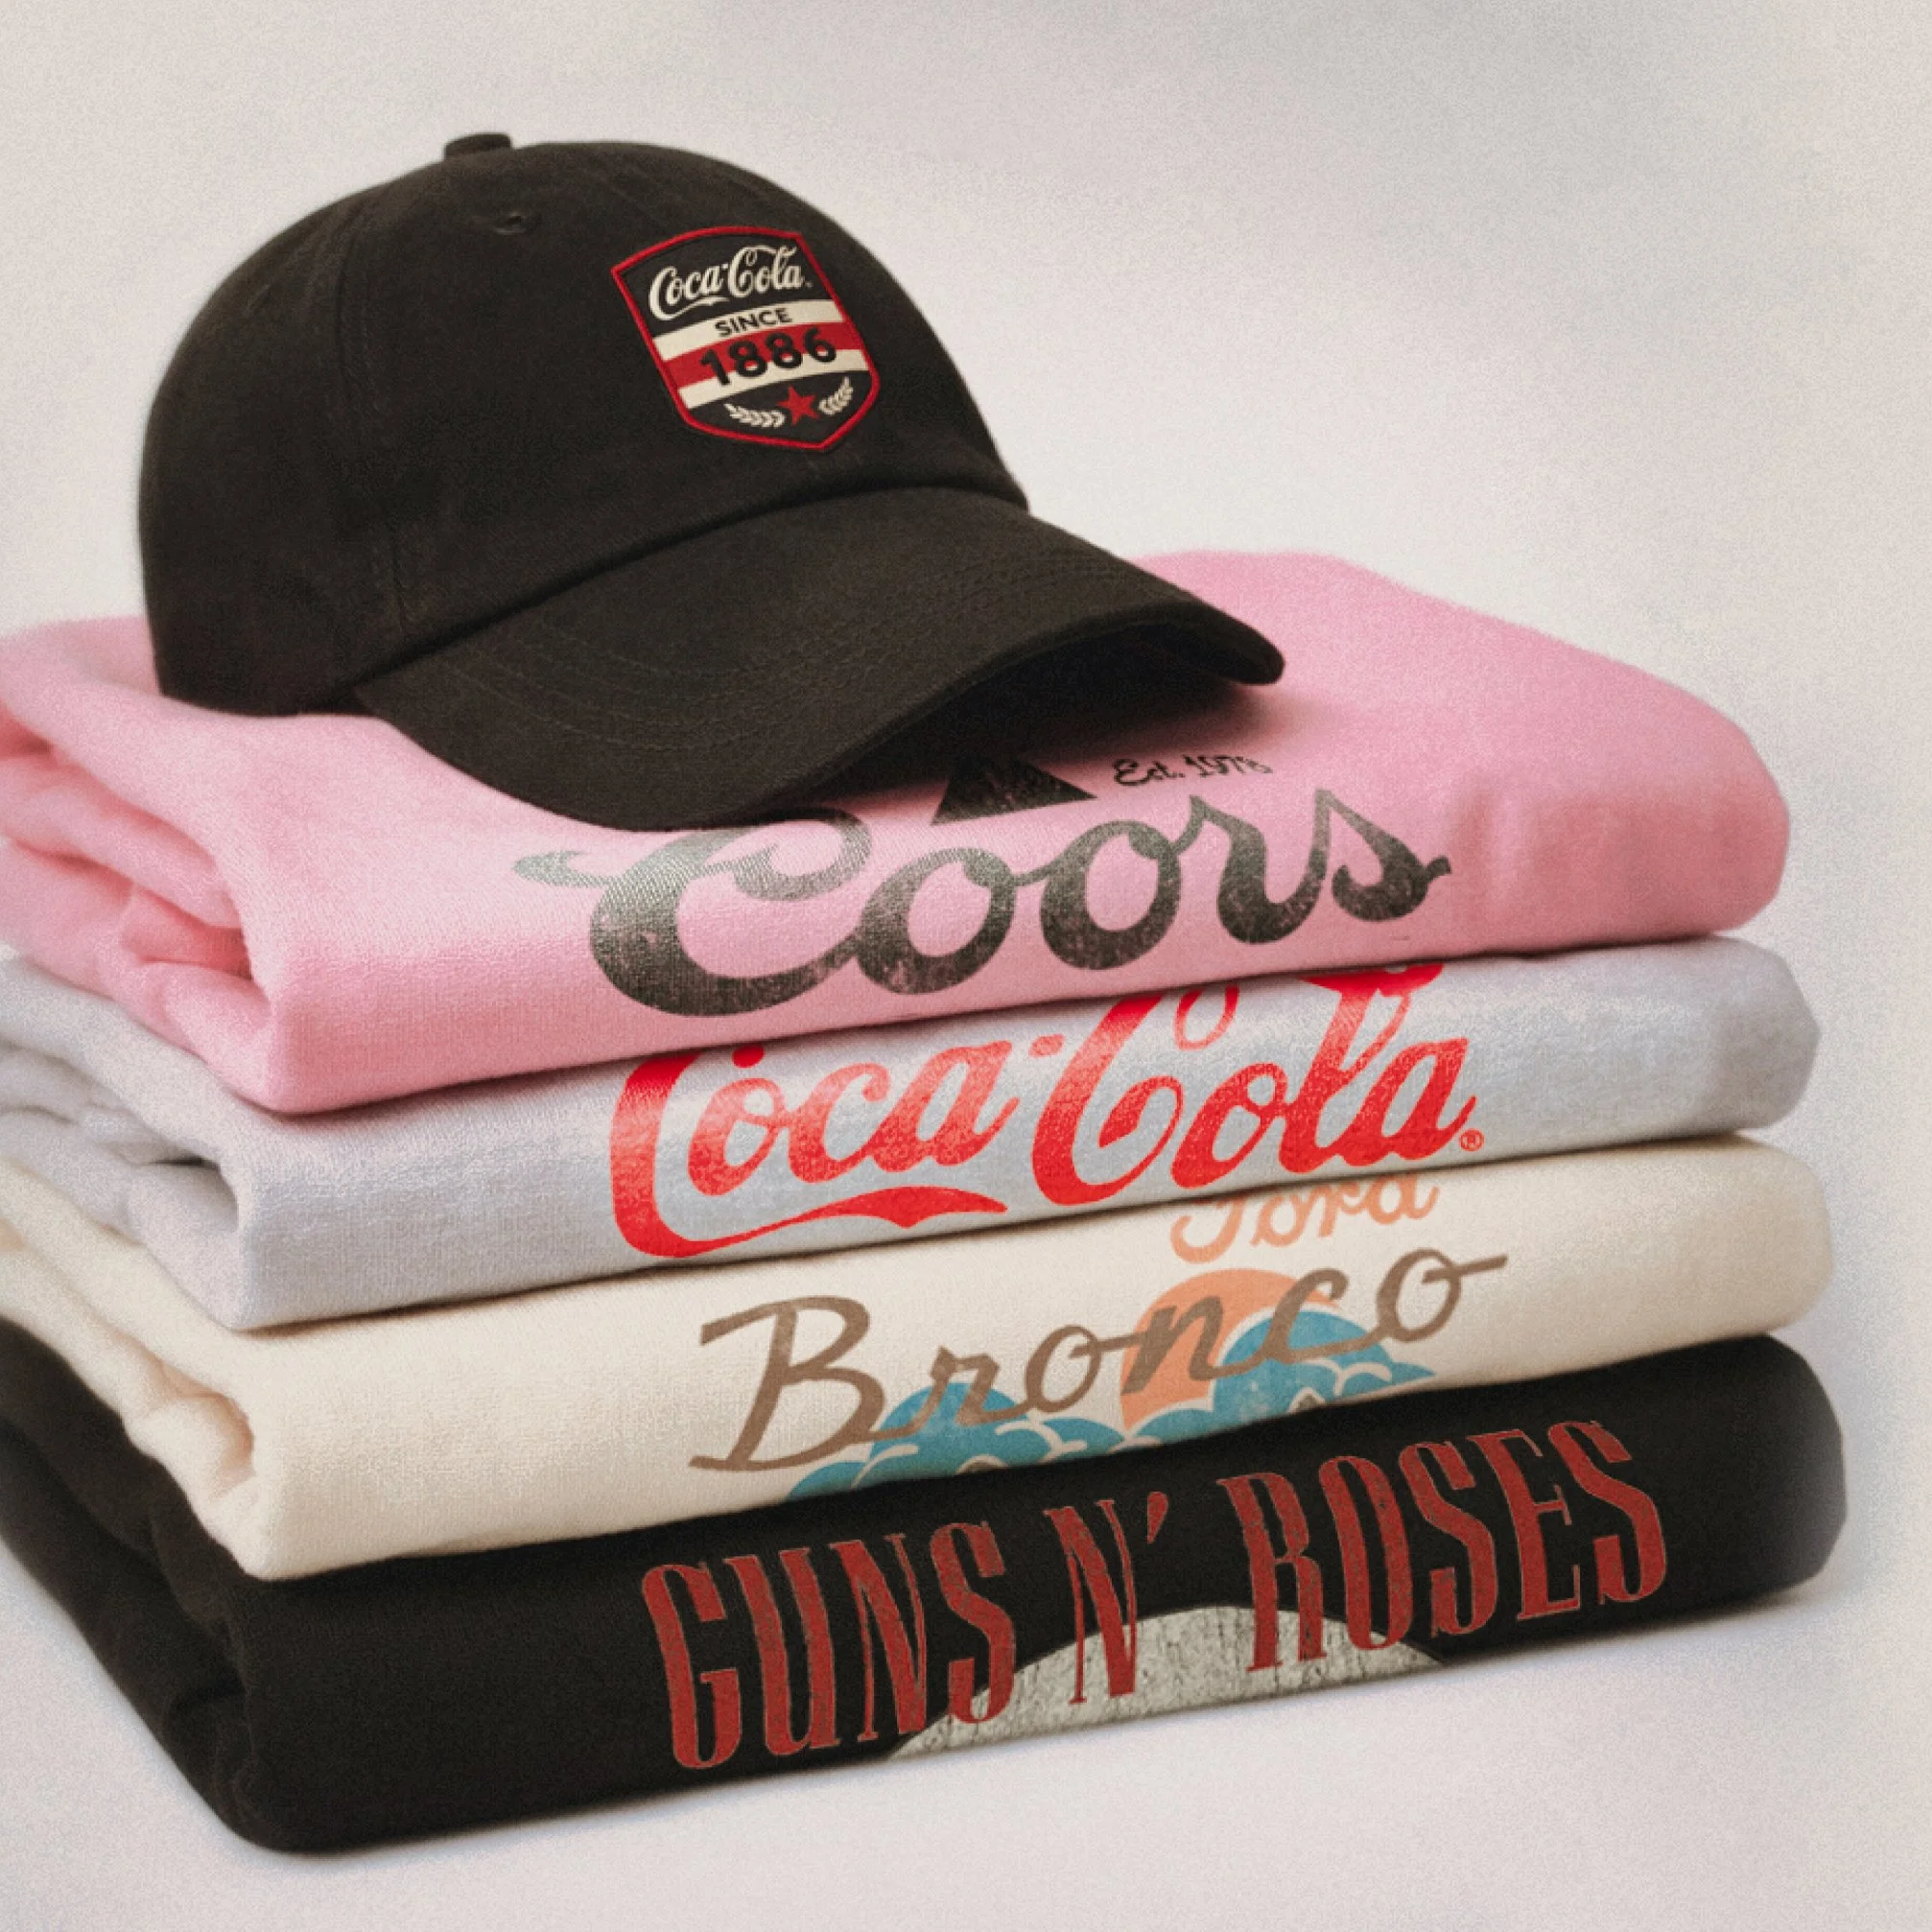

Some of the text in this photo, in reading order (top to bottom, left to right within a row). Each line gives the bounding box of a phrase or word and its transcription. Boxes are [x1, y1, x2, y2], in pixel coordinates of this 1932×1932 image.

[648, 245, 808, 320] Coca-Cola
[699, 327, 836, 386] 1886
[715, 307, 792, 337] SINCE
[512, 788, 1451, 1017] Coors
[609, 963, 1475, 1259] Coca-Cola
[688, 1247, 1508, 1473] Bronco
[642, 1520, 1020, 1770] GUNS
[1218, 1419, 1668, 1676] ROSES
